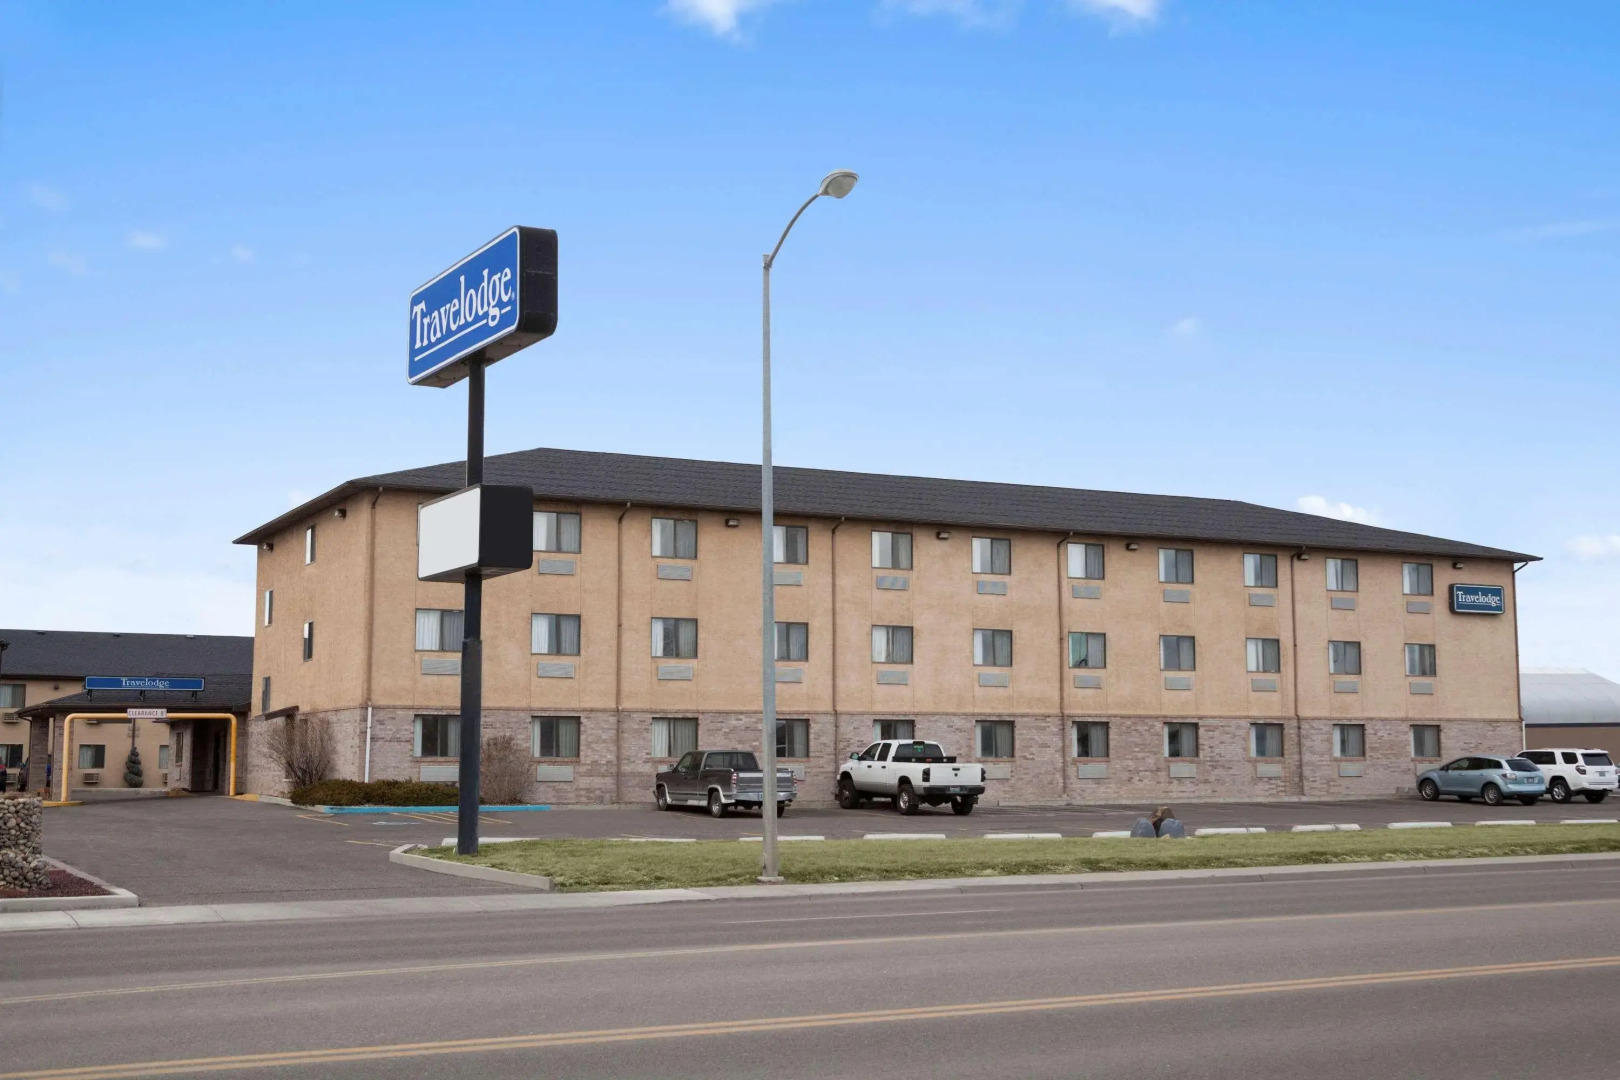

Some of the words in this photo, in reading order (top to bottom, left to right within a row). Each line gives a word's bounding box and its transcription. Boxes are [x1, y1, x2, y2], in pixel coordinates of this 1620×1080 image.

[411, 267, 512, 349] Travelodge
[1456, 591, 1501, 607] Travelodge
[120, 678, 170, 689] Travelodge
